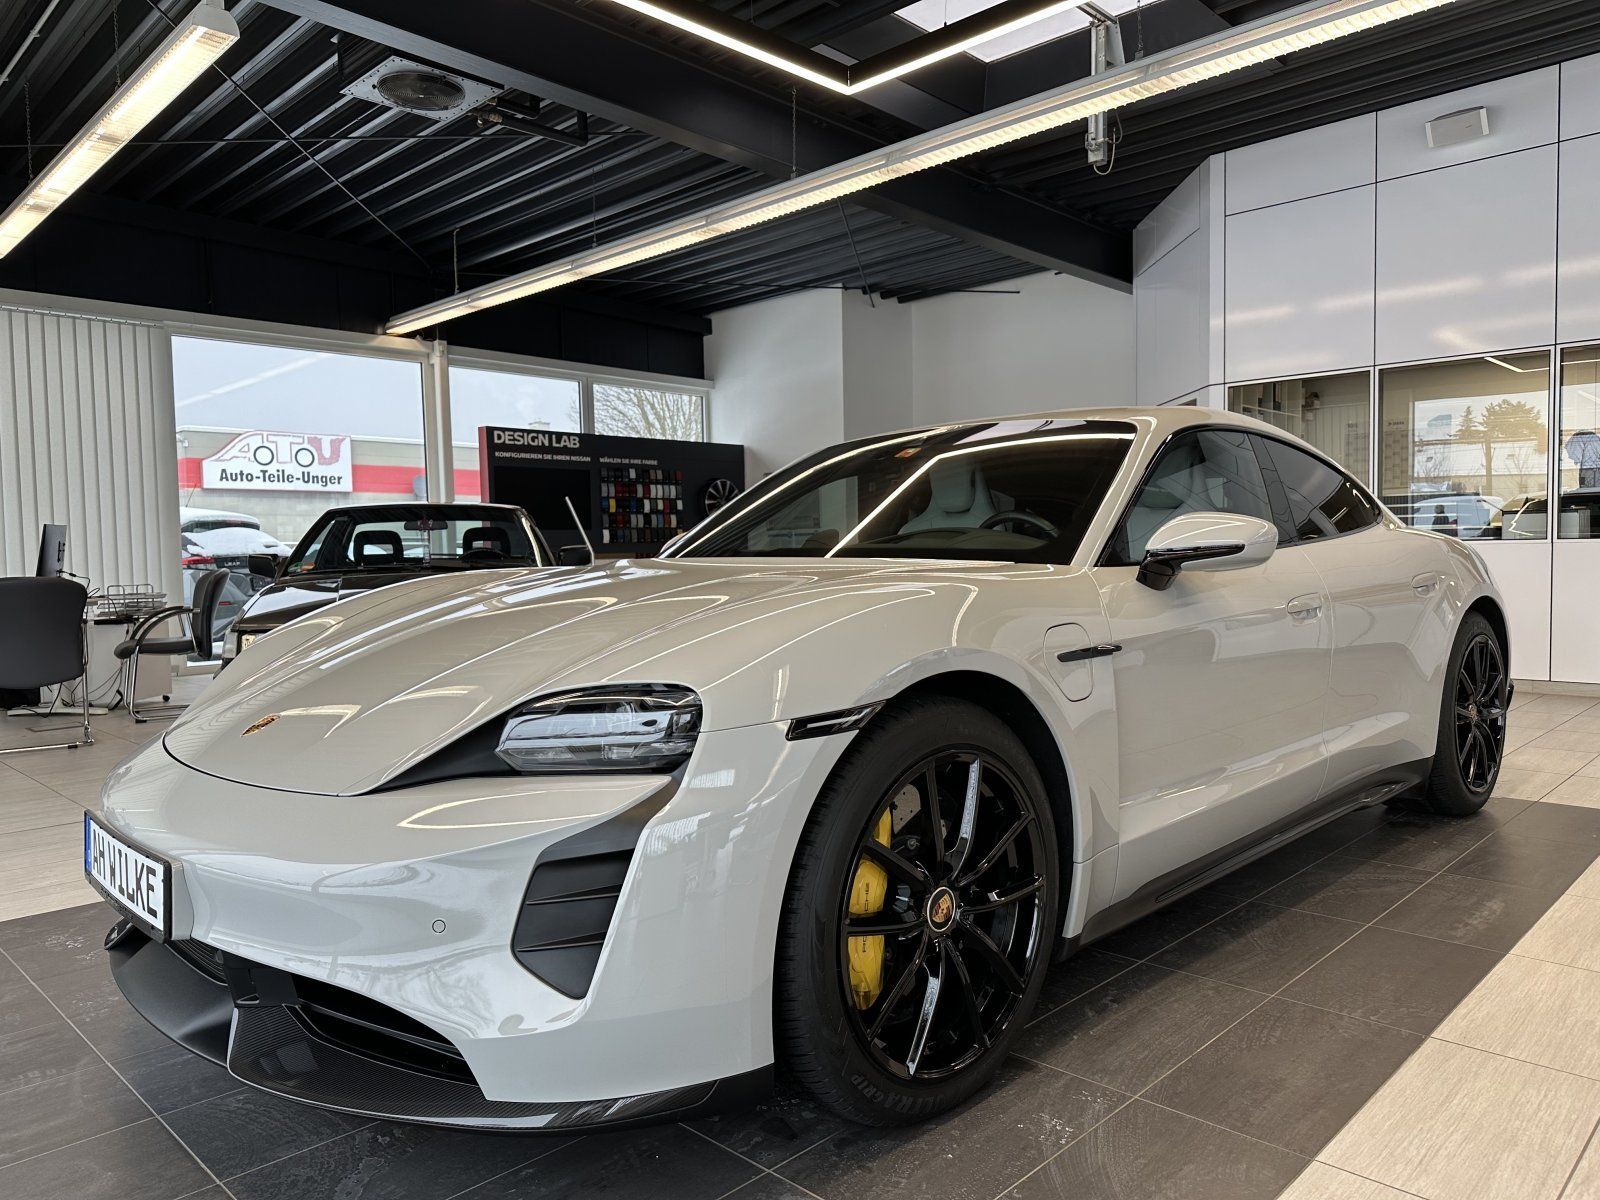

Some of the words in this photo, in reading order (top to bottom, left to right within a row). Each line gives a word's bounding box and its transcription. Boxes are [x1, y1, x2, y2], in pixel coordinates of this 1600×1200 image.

[493, 430, 549, 446] DESIGN
[552, 434, 580, 448] LAB
[495, 451, 543, 460] KONFIGURIEREN
[219, 468, 343, 486] Auto-Teile-Unger
[108, 841, 158, 919] WILKE
